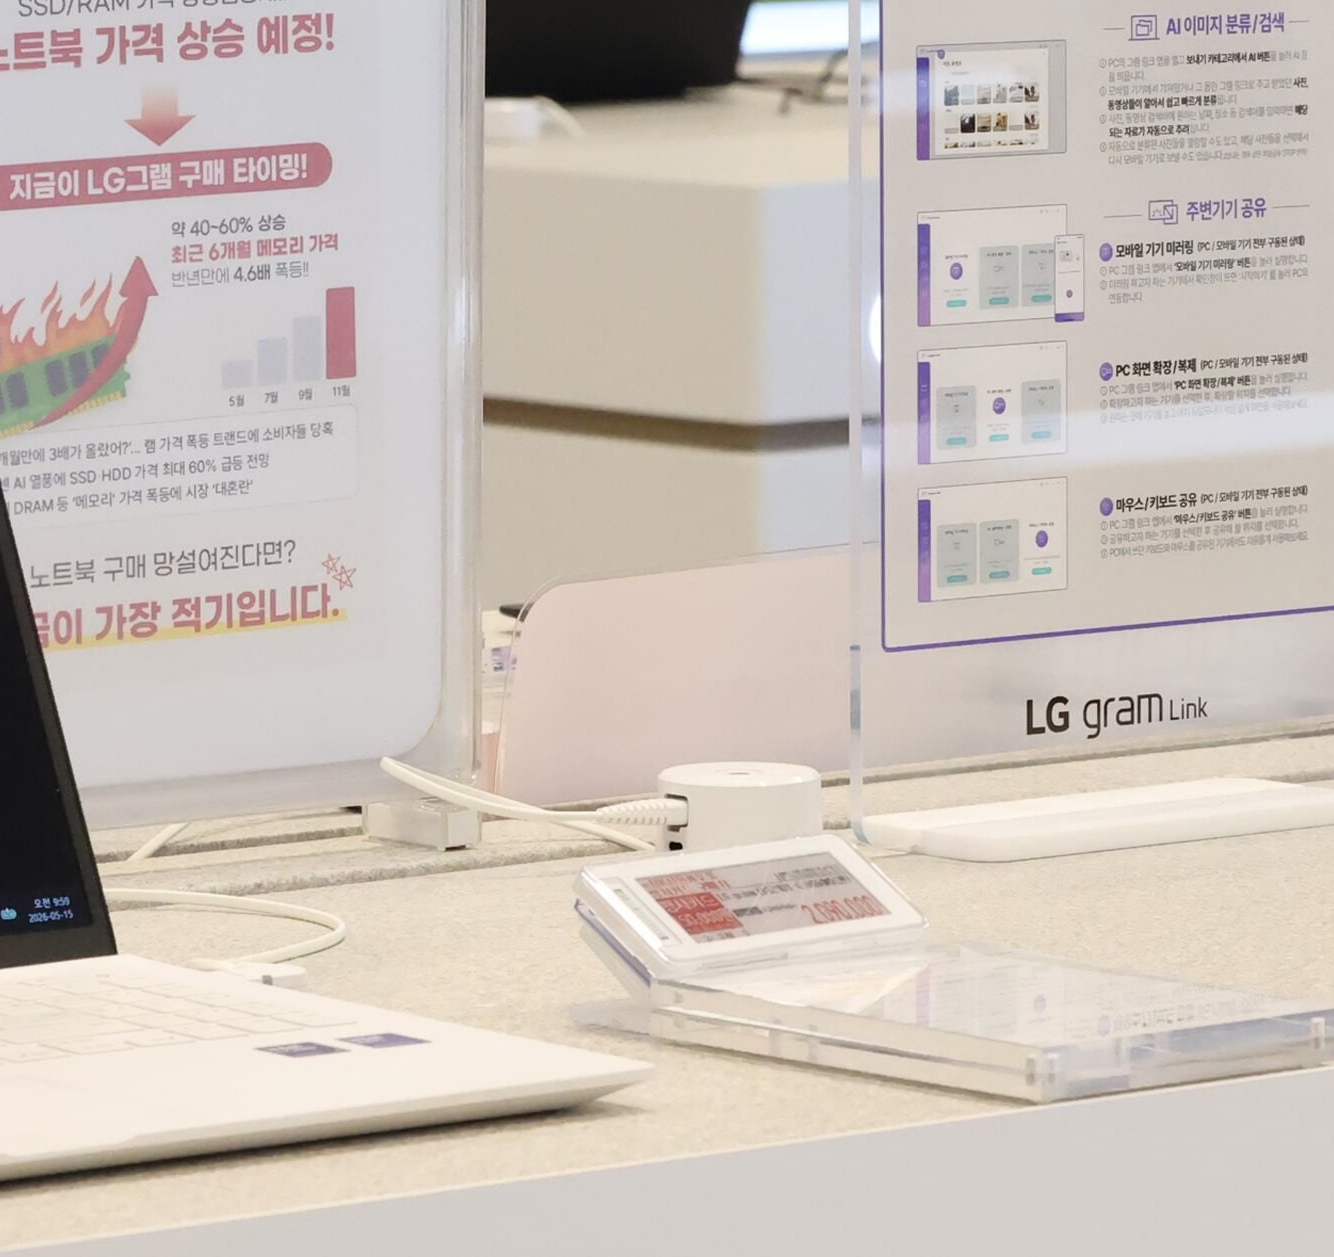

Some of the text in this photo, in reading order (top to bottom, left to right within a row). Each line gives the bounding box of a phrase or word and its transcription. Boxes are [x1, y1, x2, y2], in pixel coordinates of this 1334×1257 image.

[96, 22, 164, 64] 가격
[177, 18, 245, 61] 상승
[256, 12, 335, 55] 예정!
[1166, 18, 1181, 35] AI
[1184, 14, 1222, 36] 이미지
[9, 153, 308, 201] 지금이 LG그램 구매 타이밍!
[1186, 197, 1267, 221] 주변기기 공유
[171, 214, 286, 237] 약 40~60% 상승
[171, 233, 339, 263] 최근 6개월 메모리 가격
[1115, 243, 1143, 258] 모바일
[1145, 242, 1164, 257] 기기
[1165, 240, 1194, 255] 미러링
[171, 267, 230, 287] 반년만에
[233, 263, 271, 282] 4.6배
[1115, 364, 1130, 377] PC
[1132, 361, 1151, 377] 화면
[229, 394, 245, 407] 5월
[264, 391, 278, 404] 7월
[298, 388, 313, 400] 9월
[49, 445, 81, 461] 3배가
[159, 436, 183, 451] 가격
[186, 433, 209, 449] 폭등
[262, 424, 306, 441] 소비자들
[310, 421, 334, 438] 당혹
[14, 476, 26, 489] AI
[134, 464, 158, 479] 가격
[162, 461, 186, 476] 최대
[188, 459, 217, 474] 60%
[221, 455, 243, 472] 급등
[246, 452, 269, 469] 전망
[13, 499, 54, 515] DRAM
[119, 490, 142, 505] 가격
[186, 482, 209, 499] 시장
[1179, 492, 1197, 508] 공유
[30, 539, 296, 588] 노트북 구매 망설여진다면?
[95, 601, 161, 641] 가장
[172, 583, 340, 633] 적기입니다.
[1026, 692, 1208, 739] LG gram Link
